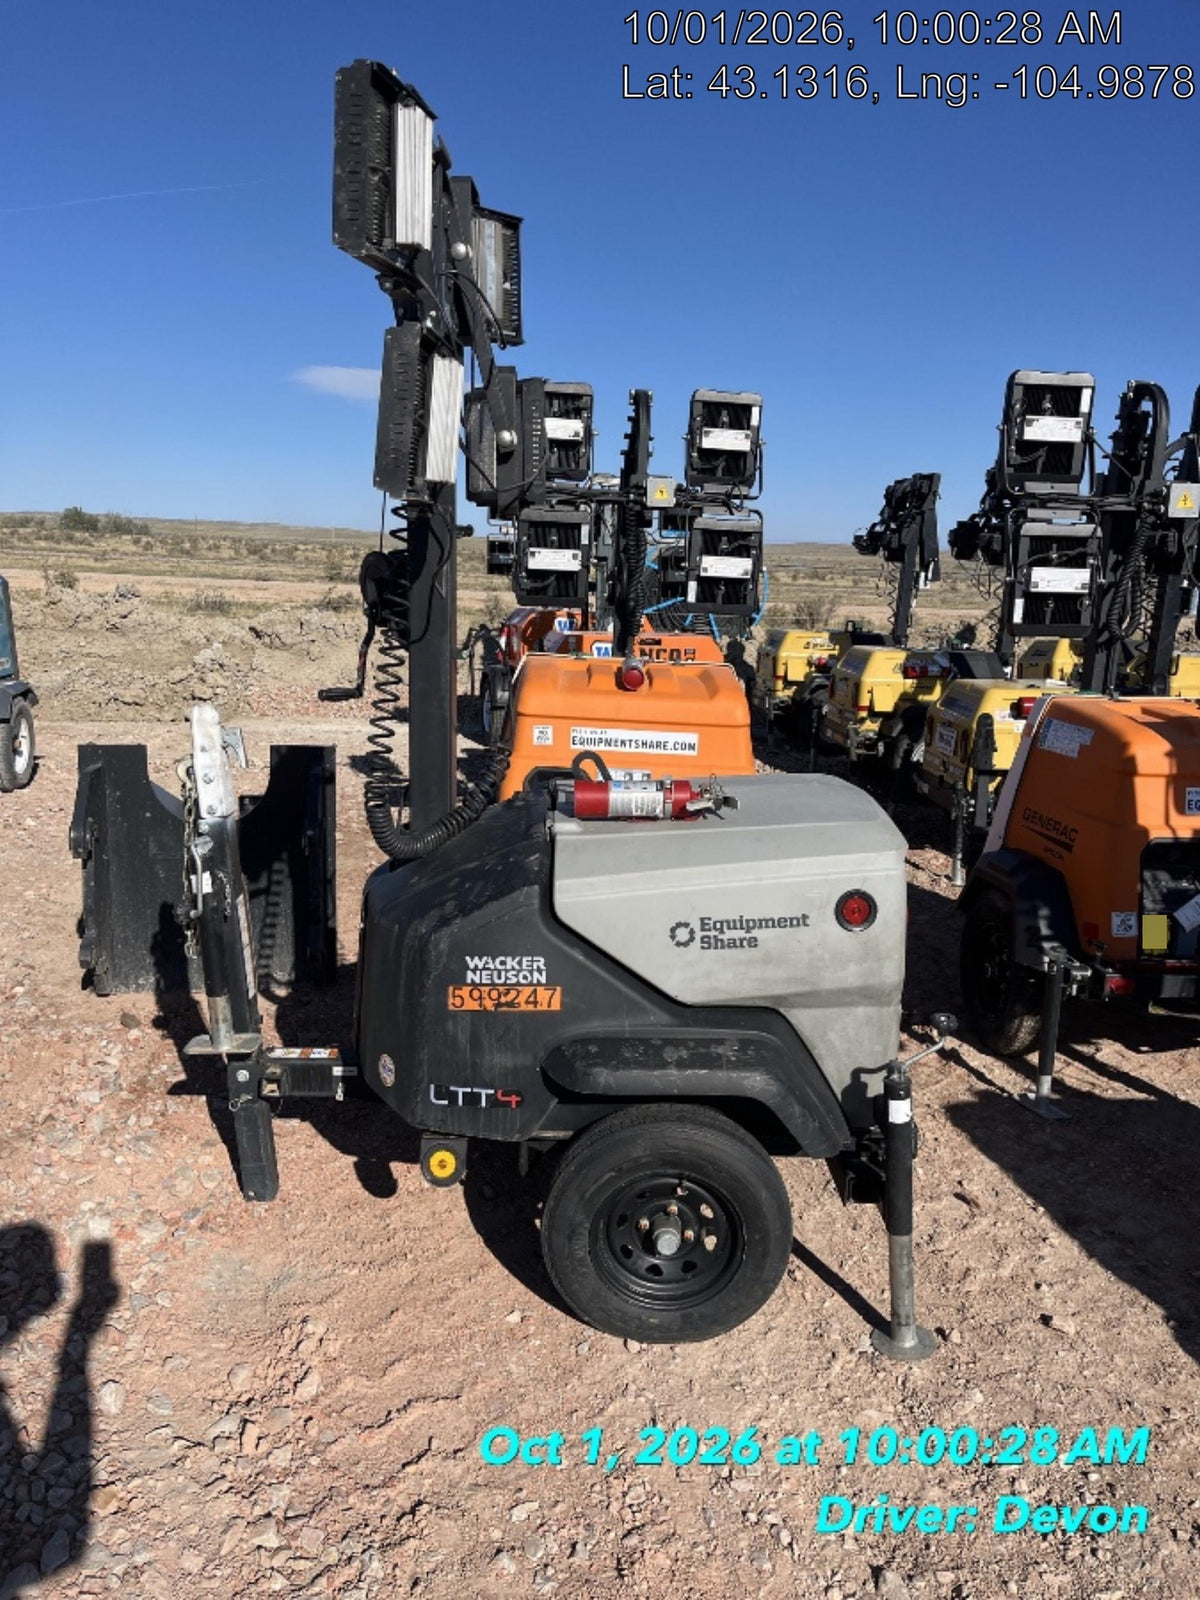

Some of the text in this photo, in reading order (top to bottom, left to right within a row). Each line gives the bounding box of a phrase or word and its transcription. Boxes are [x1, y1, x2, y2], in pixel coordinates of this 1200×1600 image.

[1022, 806, 1079, 843] GENERAC
[700, 913, 809, 932] Equipment
[700, 934, 759, 950] Share
[465, 955, 546, 970] WACKER
[466, 970, 547, 985] NEUSON
[450, 987, 558, 1010] 599247
[429, 1084, 522, 1108] LTT4
